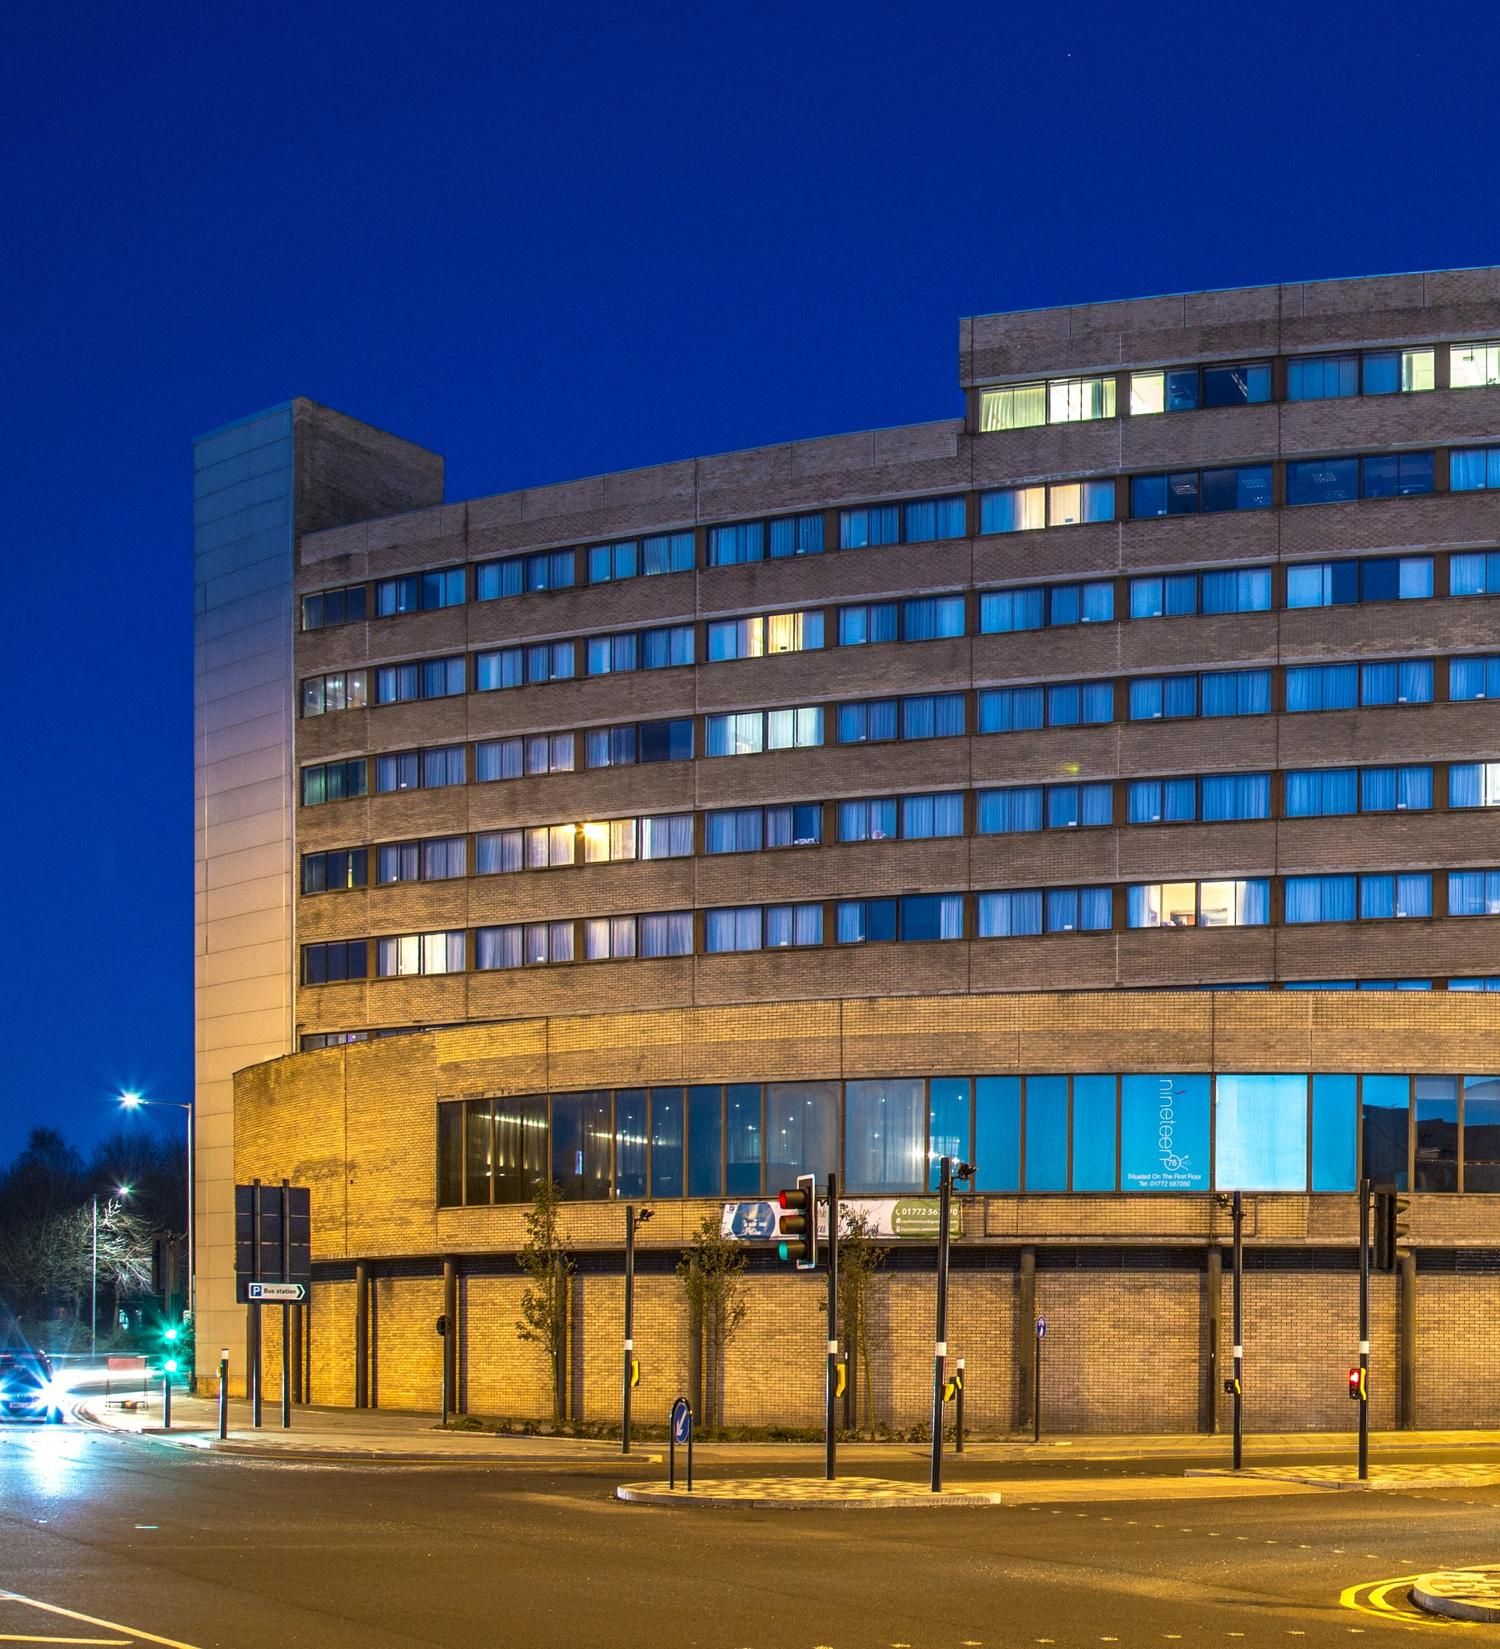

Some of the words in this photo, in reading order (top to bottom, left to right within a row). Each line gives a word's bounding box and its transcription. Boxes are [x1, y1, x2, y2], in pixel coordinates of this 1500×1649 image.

[1159, 1079, 1176, 1161] nineteen
[1149, 1180, 1168, 1188] 01772
[901, 1207, 926, 1216] 01772
